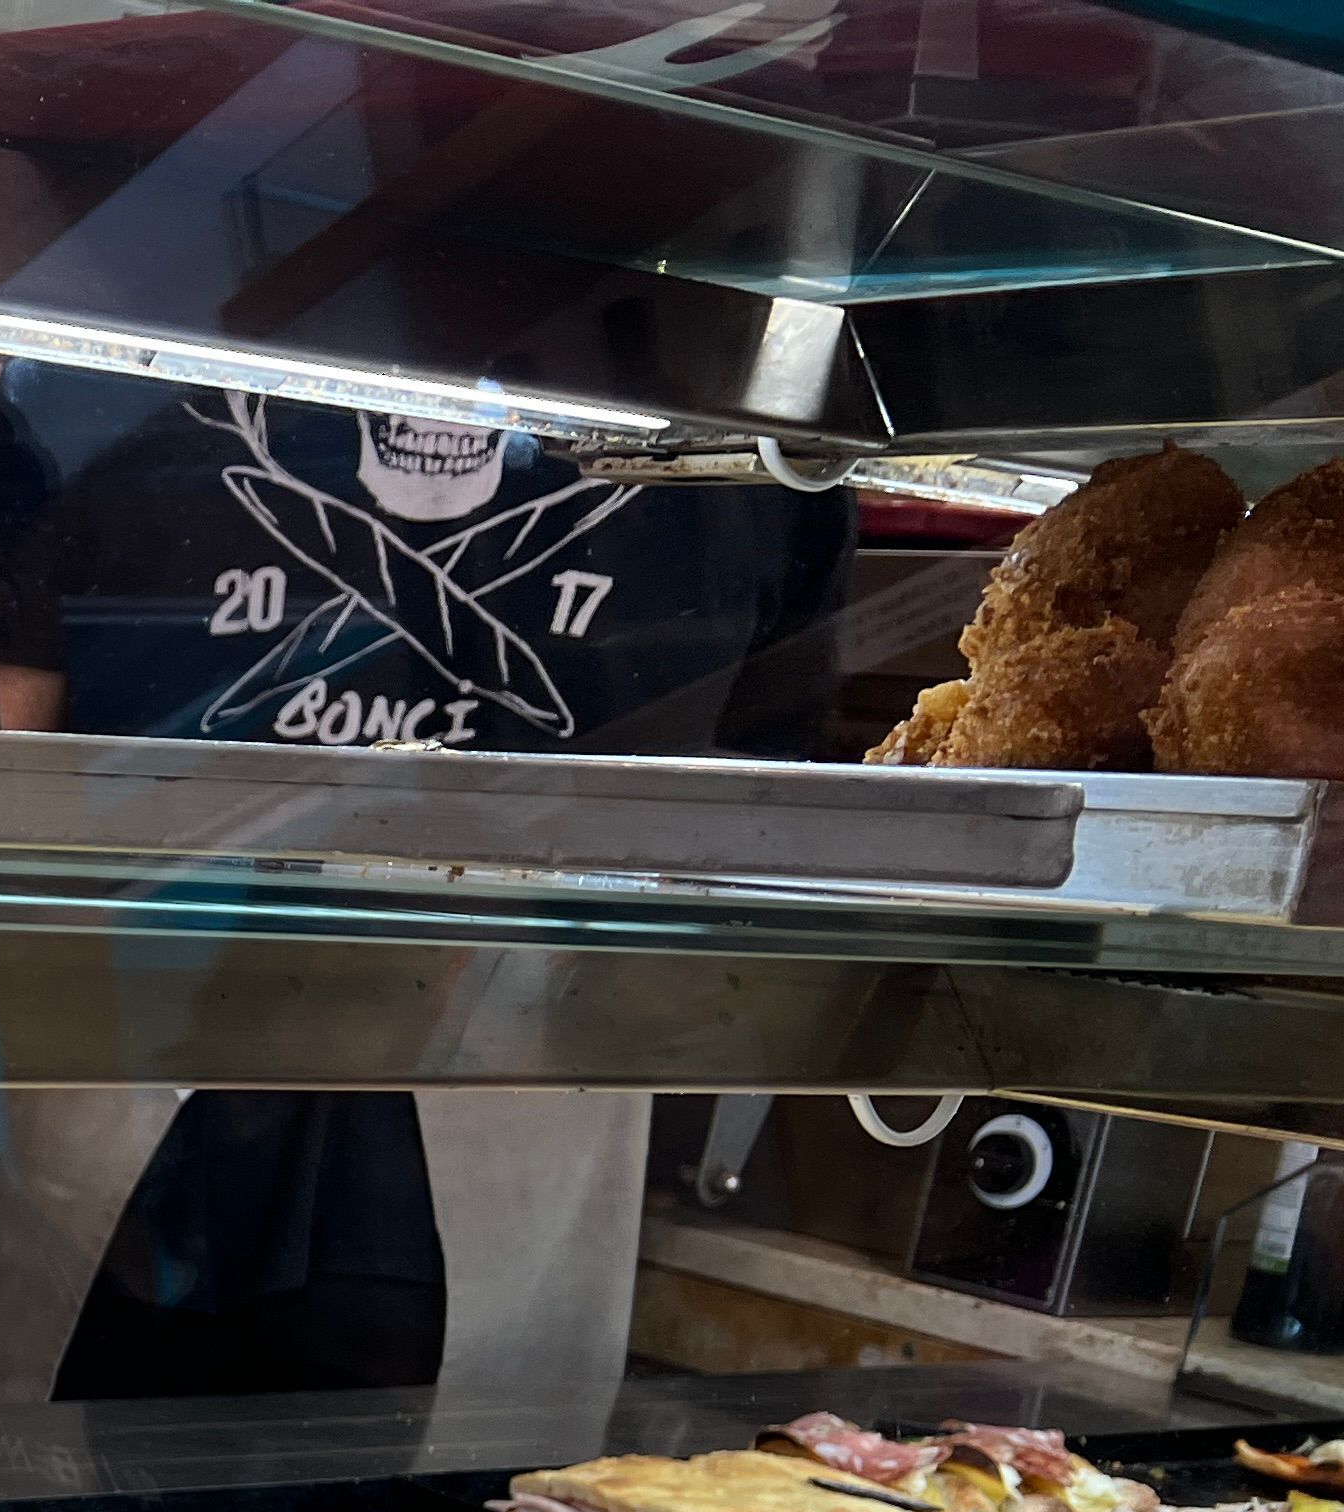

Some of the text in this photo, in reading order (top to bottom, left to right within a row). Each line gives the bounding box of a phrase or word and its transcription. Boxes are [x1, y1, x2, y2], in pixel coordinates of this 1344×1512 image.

[209, 565, 613, 638] 20 17
[271, 676, 479, 746] BONCI
